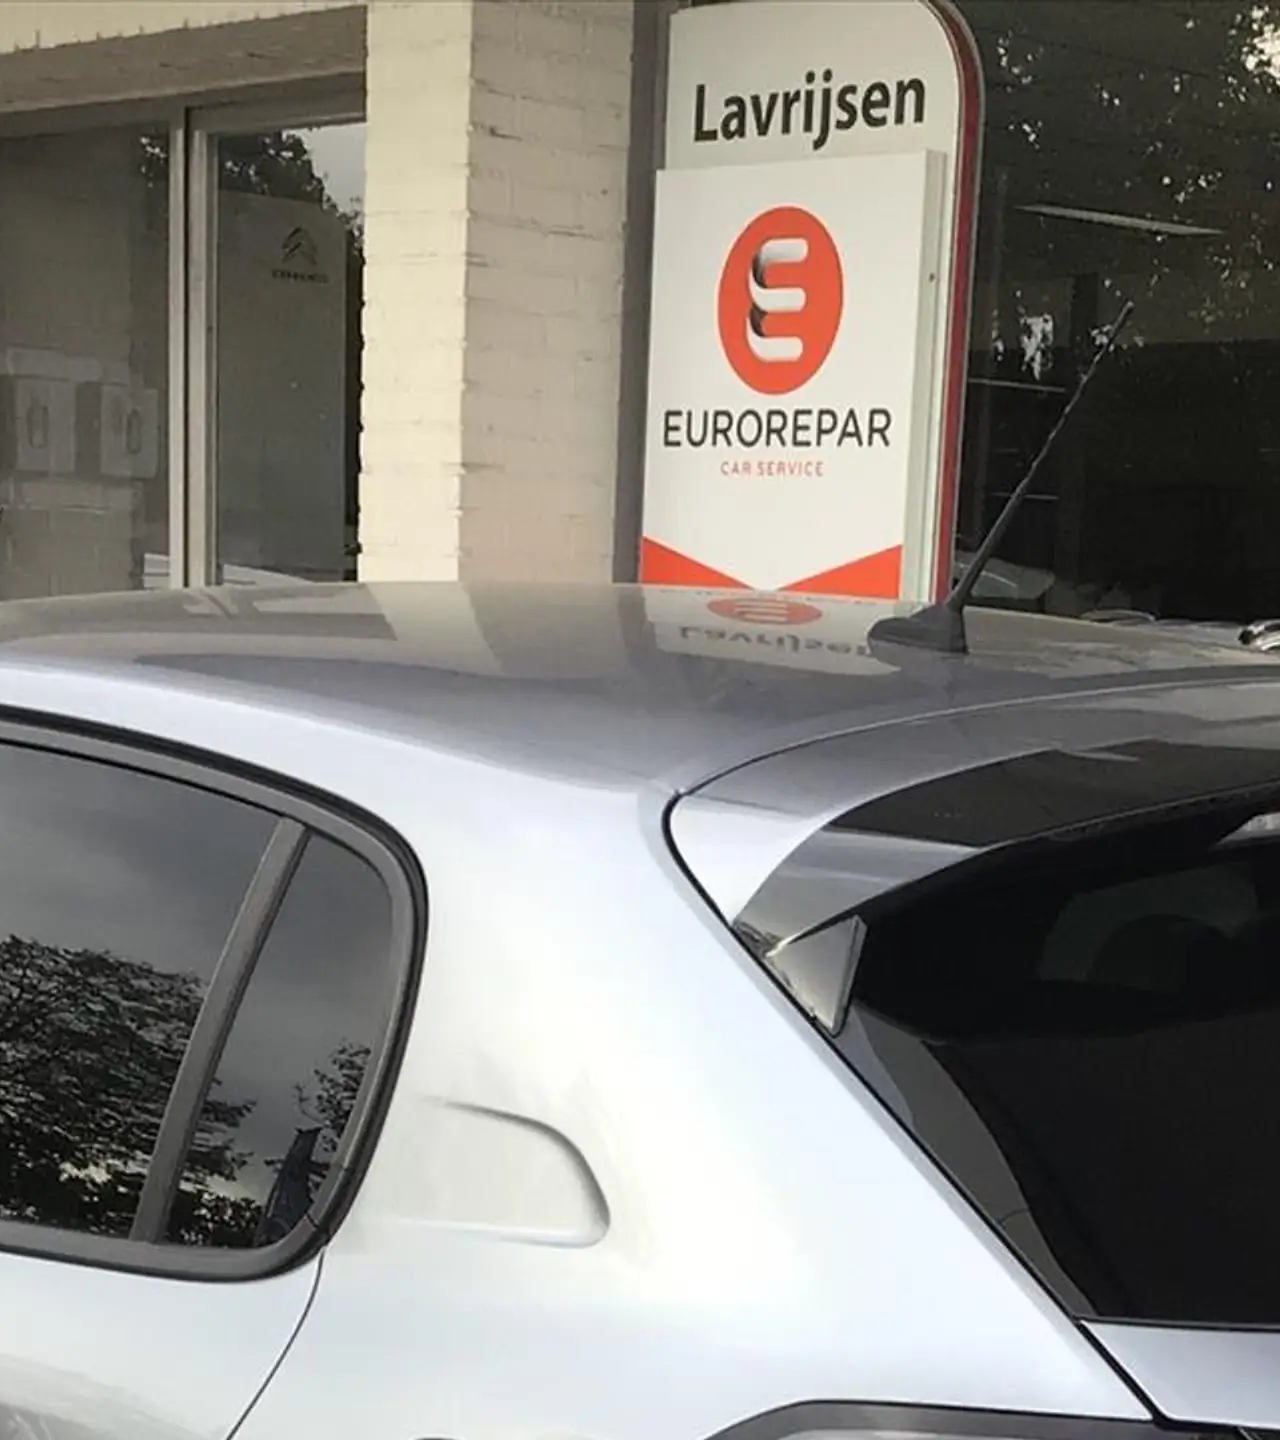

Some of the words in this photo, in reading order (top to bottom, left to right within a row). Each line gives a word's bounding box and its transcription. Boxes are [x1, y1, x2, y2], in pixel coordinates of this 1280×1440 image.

[694, 69, 926, 150] Lavrijsen
[663, 408, 892, 448] EUROREPAR
[720, 461, 752, 476] CAR
[757, 460, 824, 477] SERVICE
